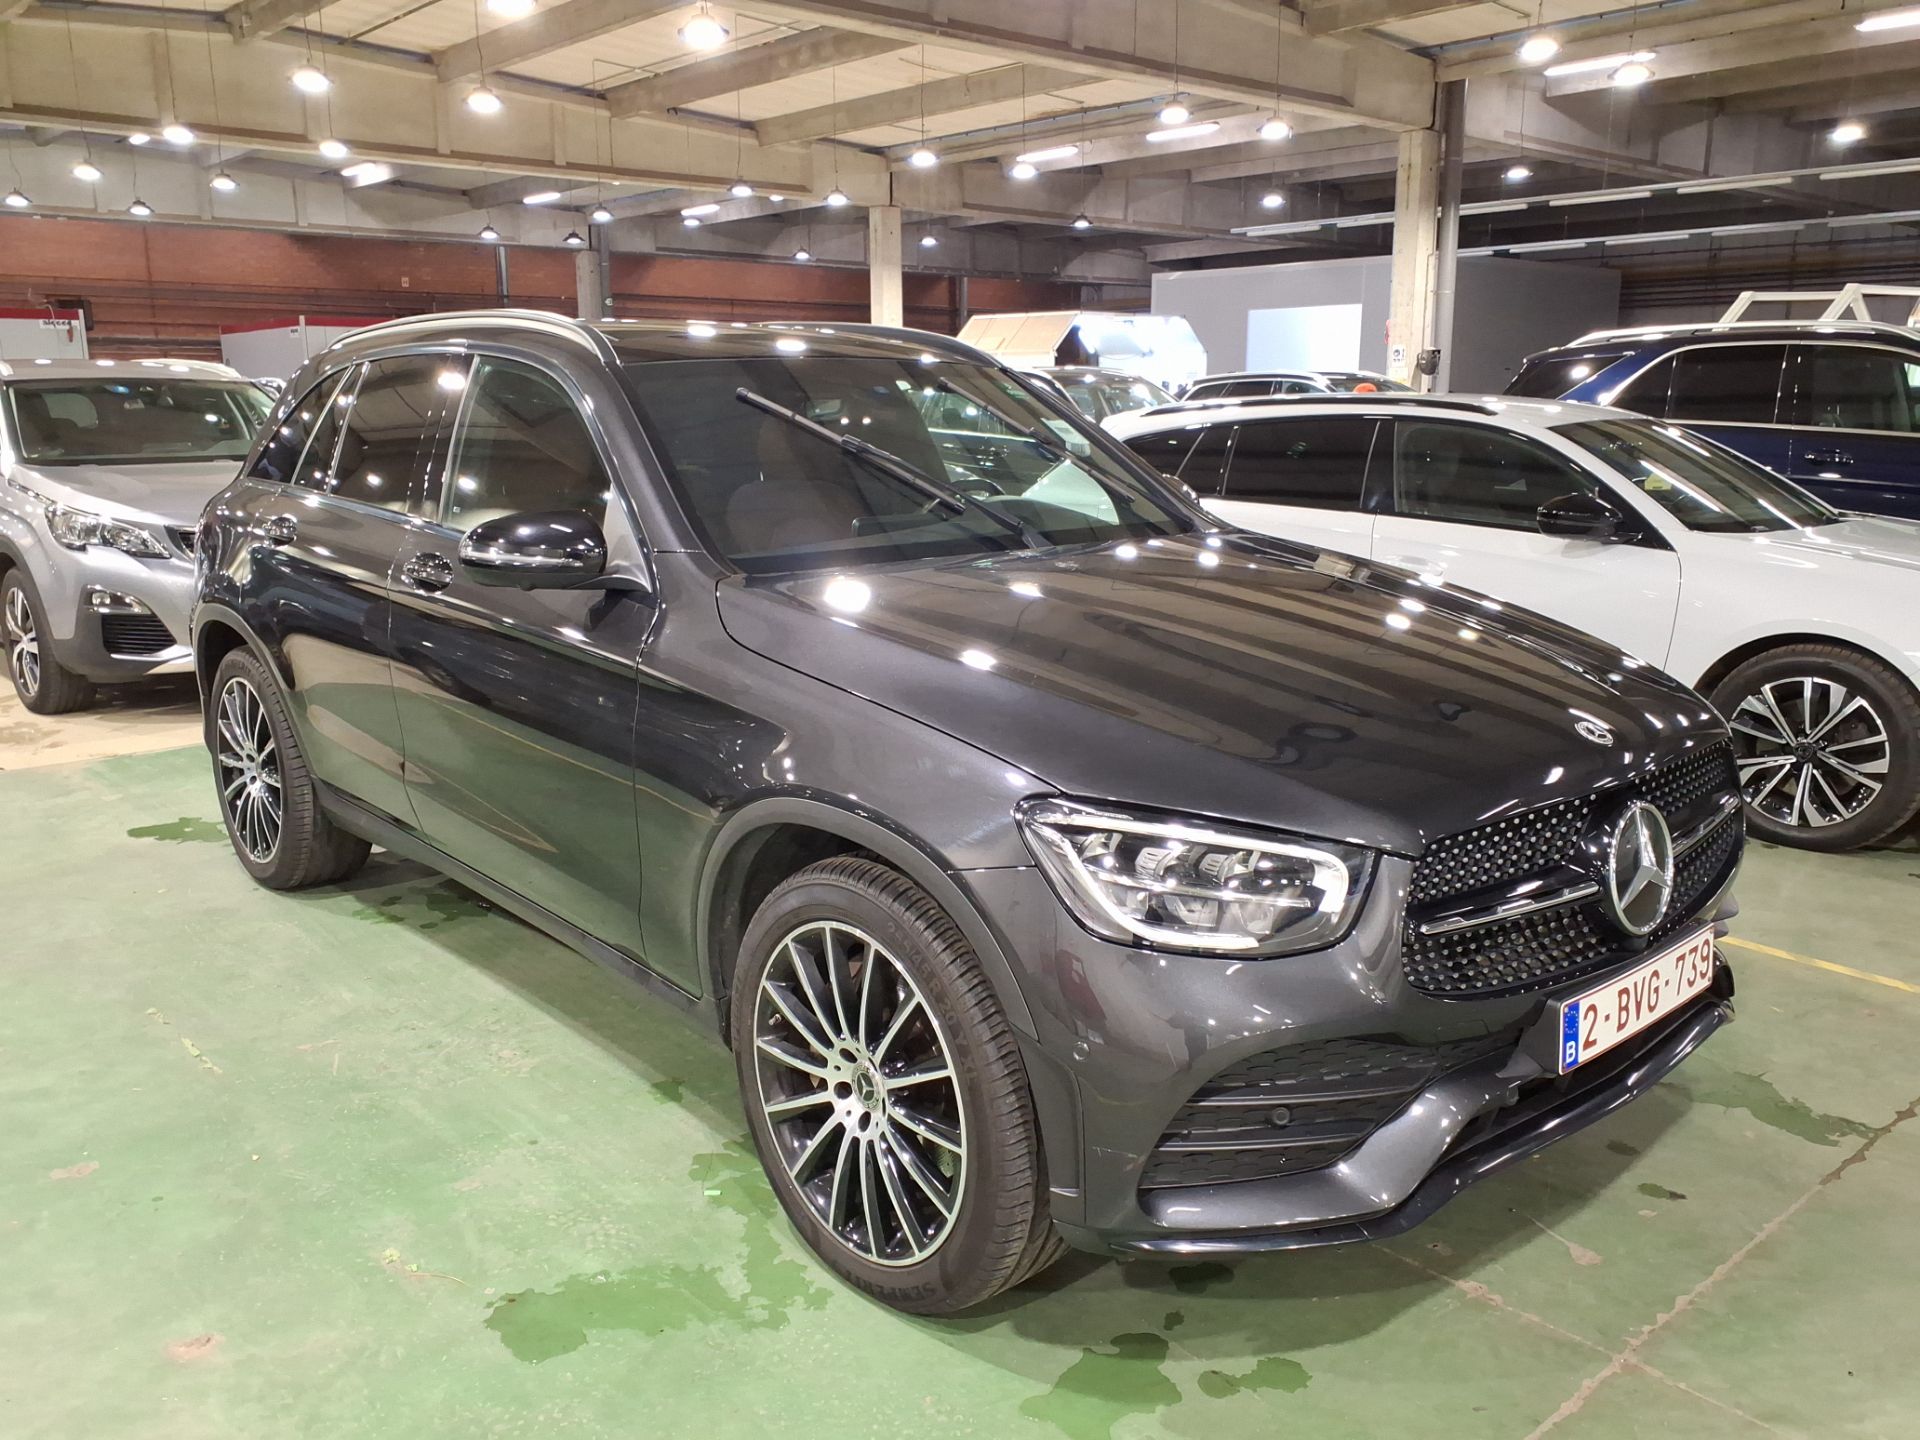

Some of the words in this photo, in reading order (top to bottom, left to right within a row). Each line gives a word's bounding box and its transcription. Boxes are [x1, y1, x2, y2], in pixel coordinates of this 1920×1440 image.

[1582, 938, 1711, 1051] 2-BVG-739
[940, 998, 958, 1024] 20
[1565, 1040, 1576, 1064] B
